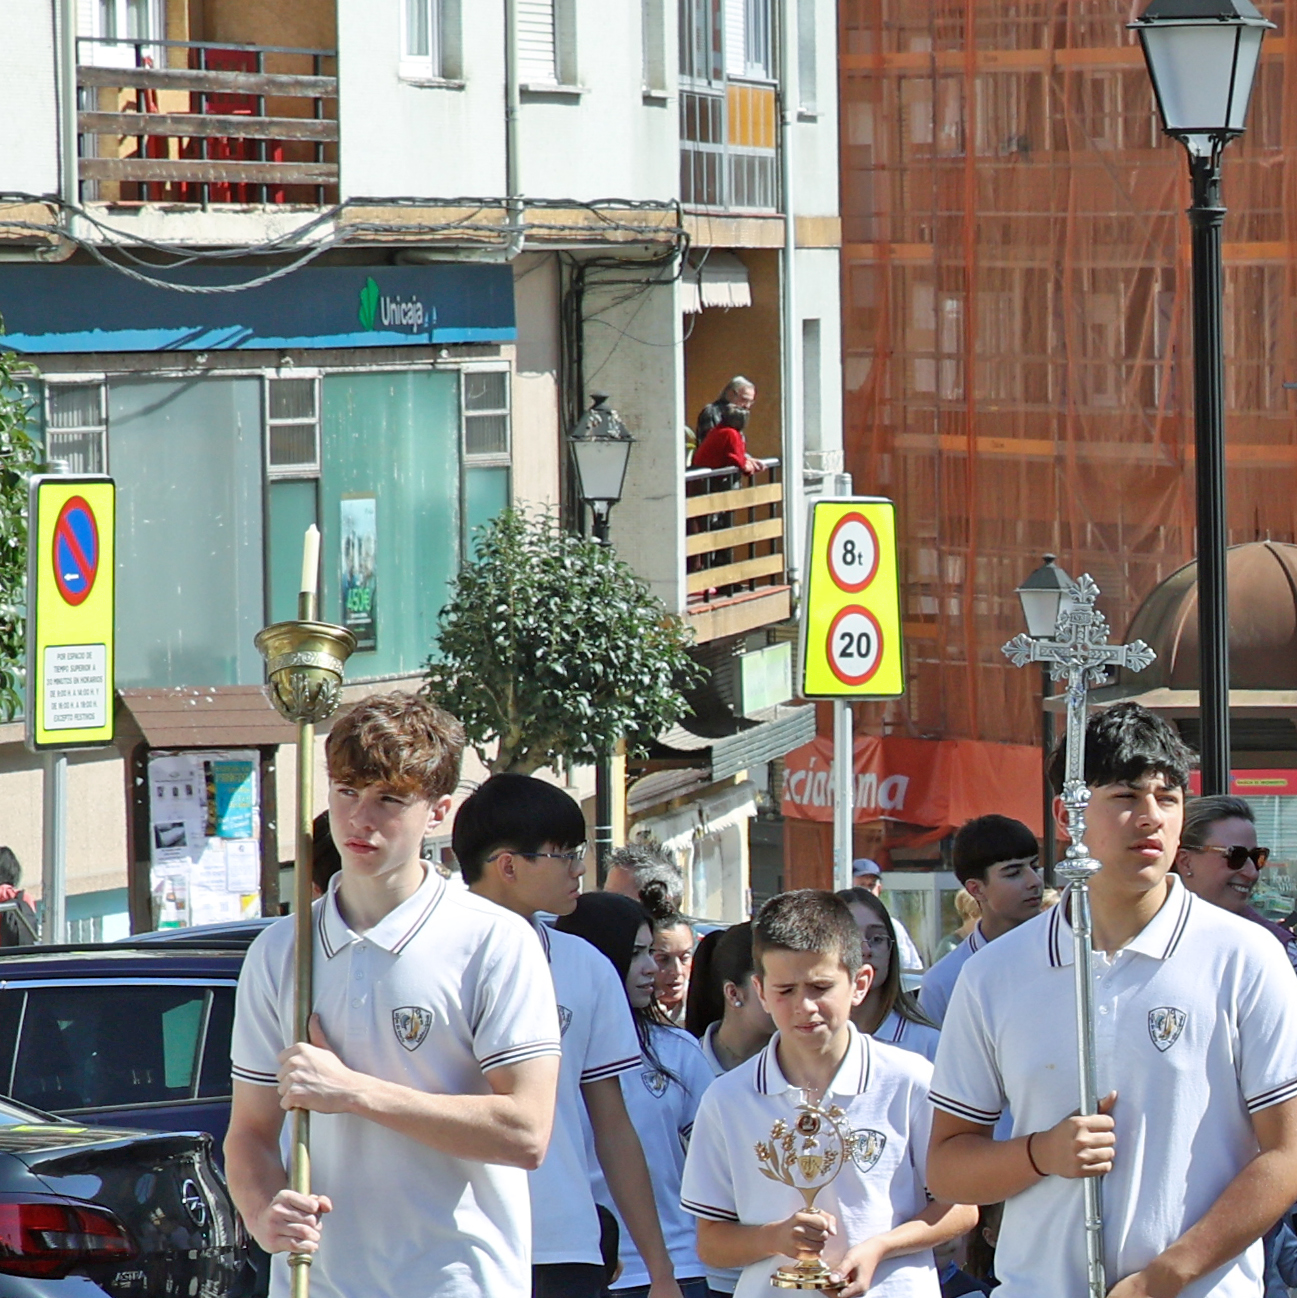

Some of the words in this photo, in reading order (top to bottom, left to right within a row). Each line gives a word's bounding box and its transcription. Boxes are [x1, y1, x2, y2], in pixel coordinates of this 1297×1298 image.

[380, 295, 424, 334] Unicaja
[838, 631, 872, 659] 20
[67, 652, 85, 660] ESPACIO
[53, 665, 69, 673] TIEMPO
[70, 664, 91, 672] SUPERIOR
[115, 1270, 145, 1282] ASTRA
